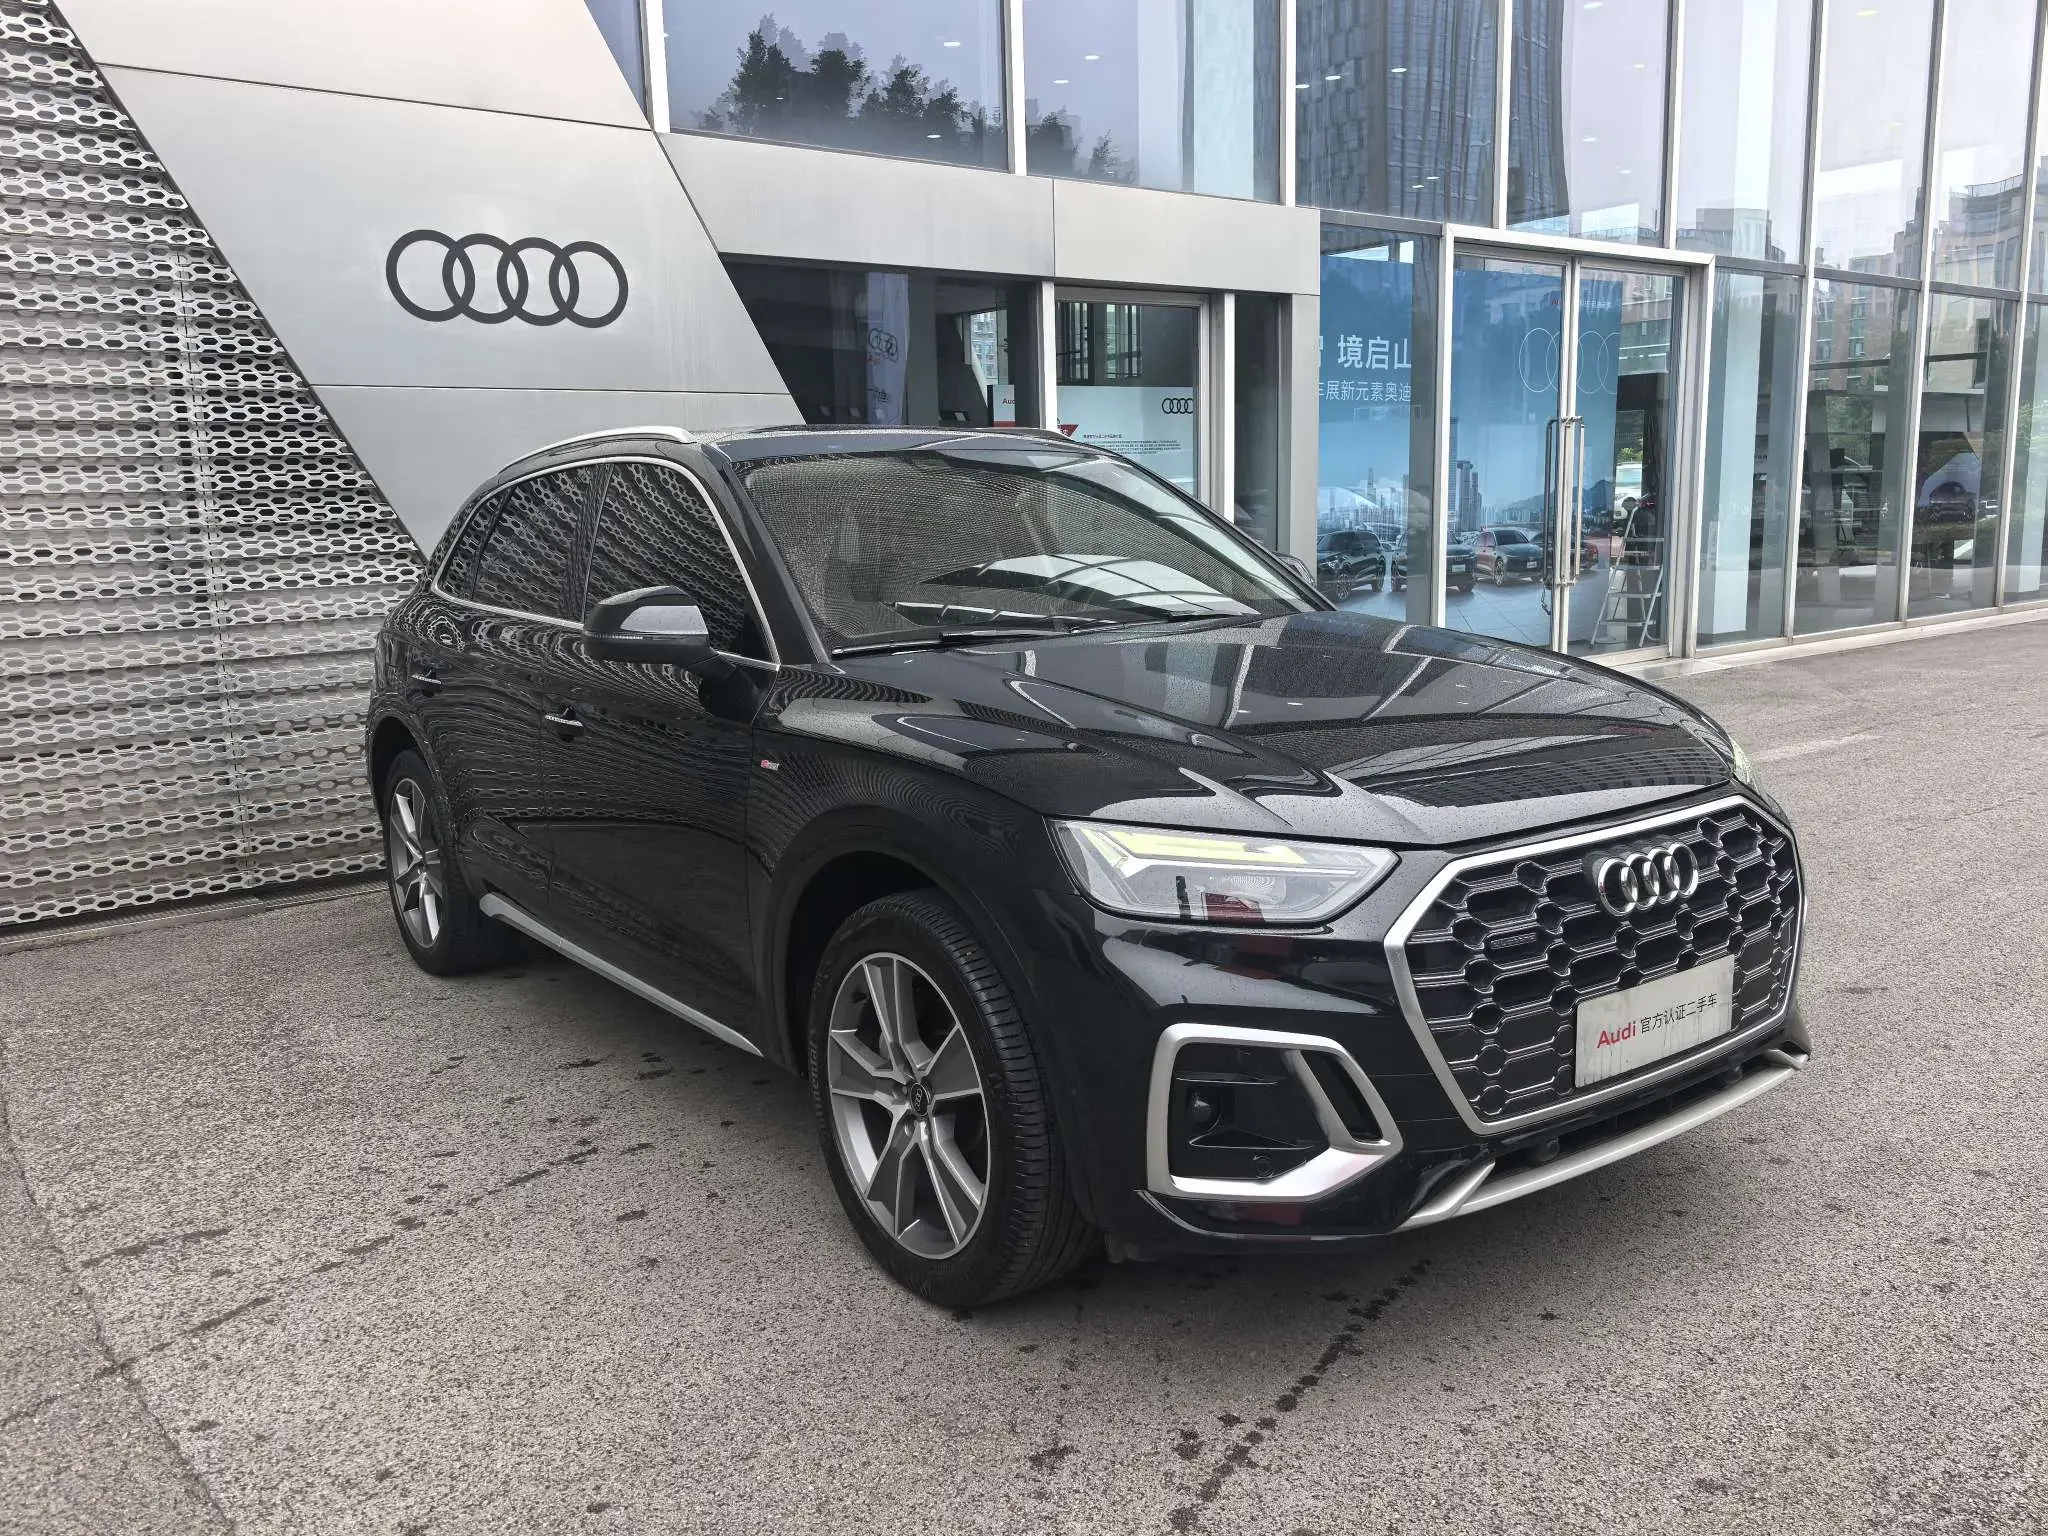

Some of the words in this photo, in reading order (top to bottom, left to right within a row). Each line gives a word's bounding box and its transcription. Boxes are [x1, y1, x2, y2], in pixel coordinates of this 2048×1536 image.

[1597, 1021, 1636, 1048] Audi
[1640, 993, 1718, 1034] 官方认证二手车
